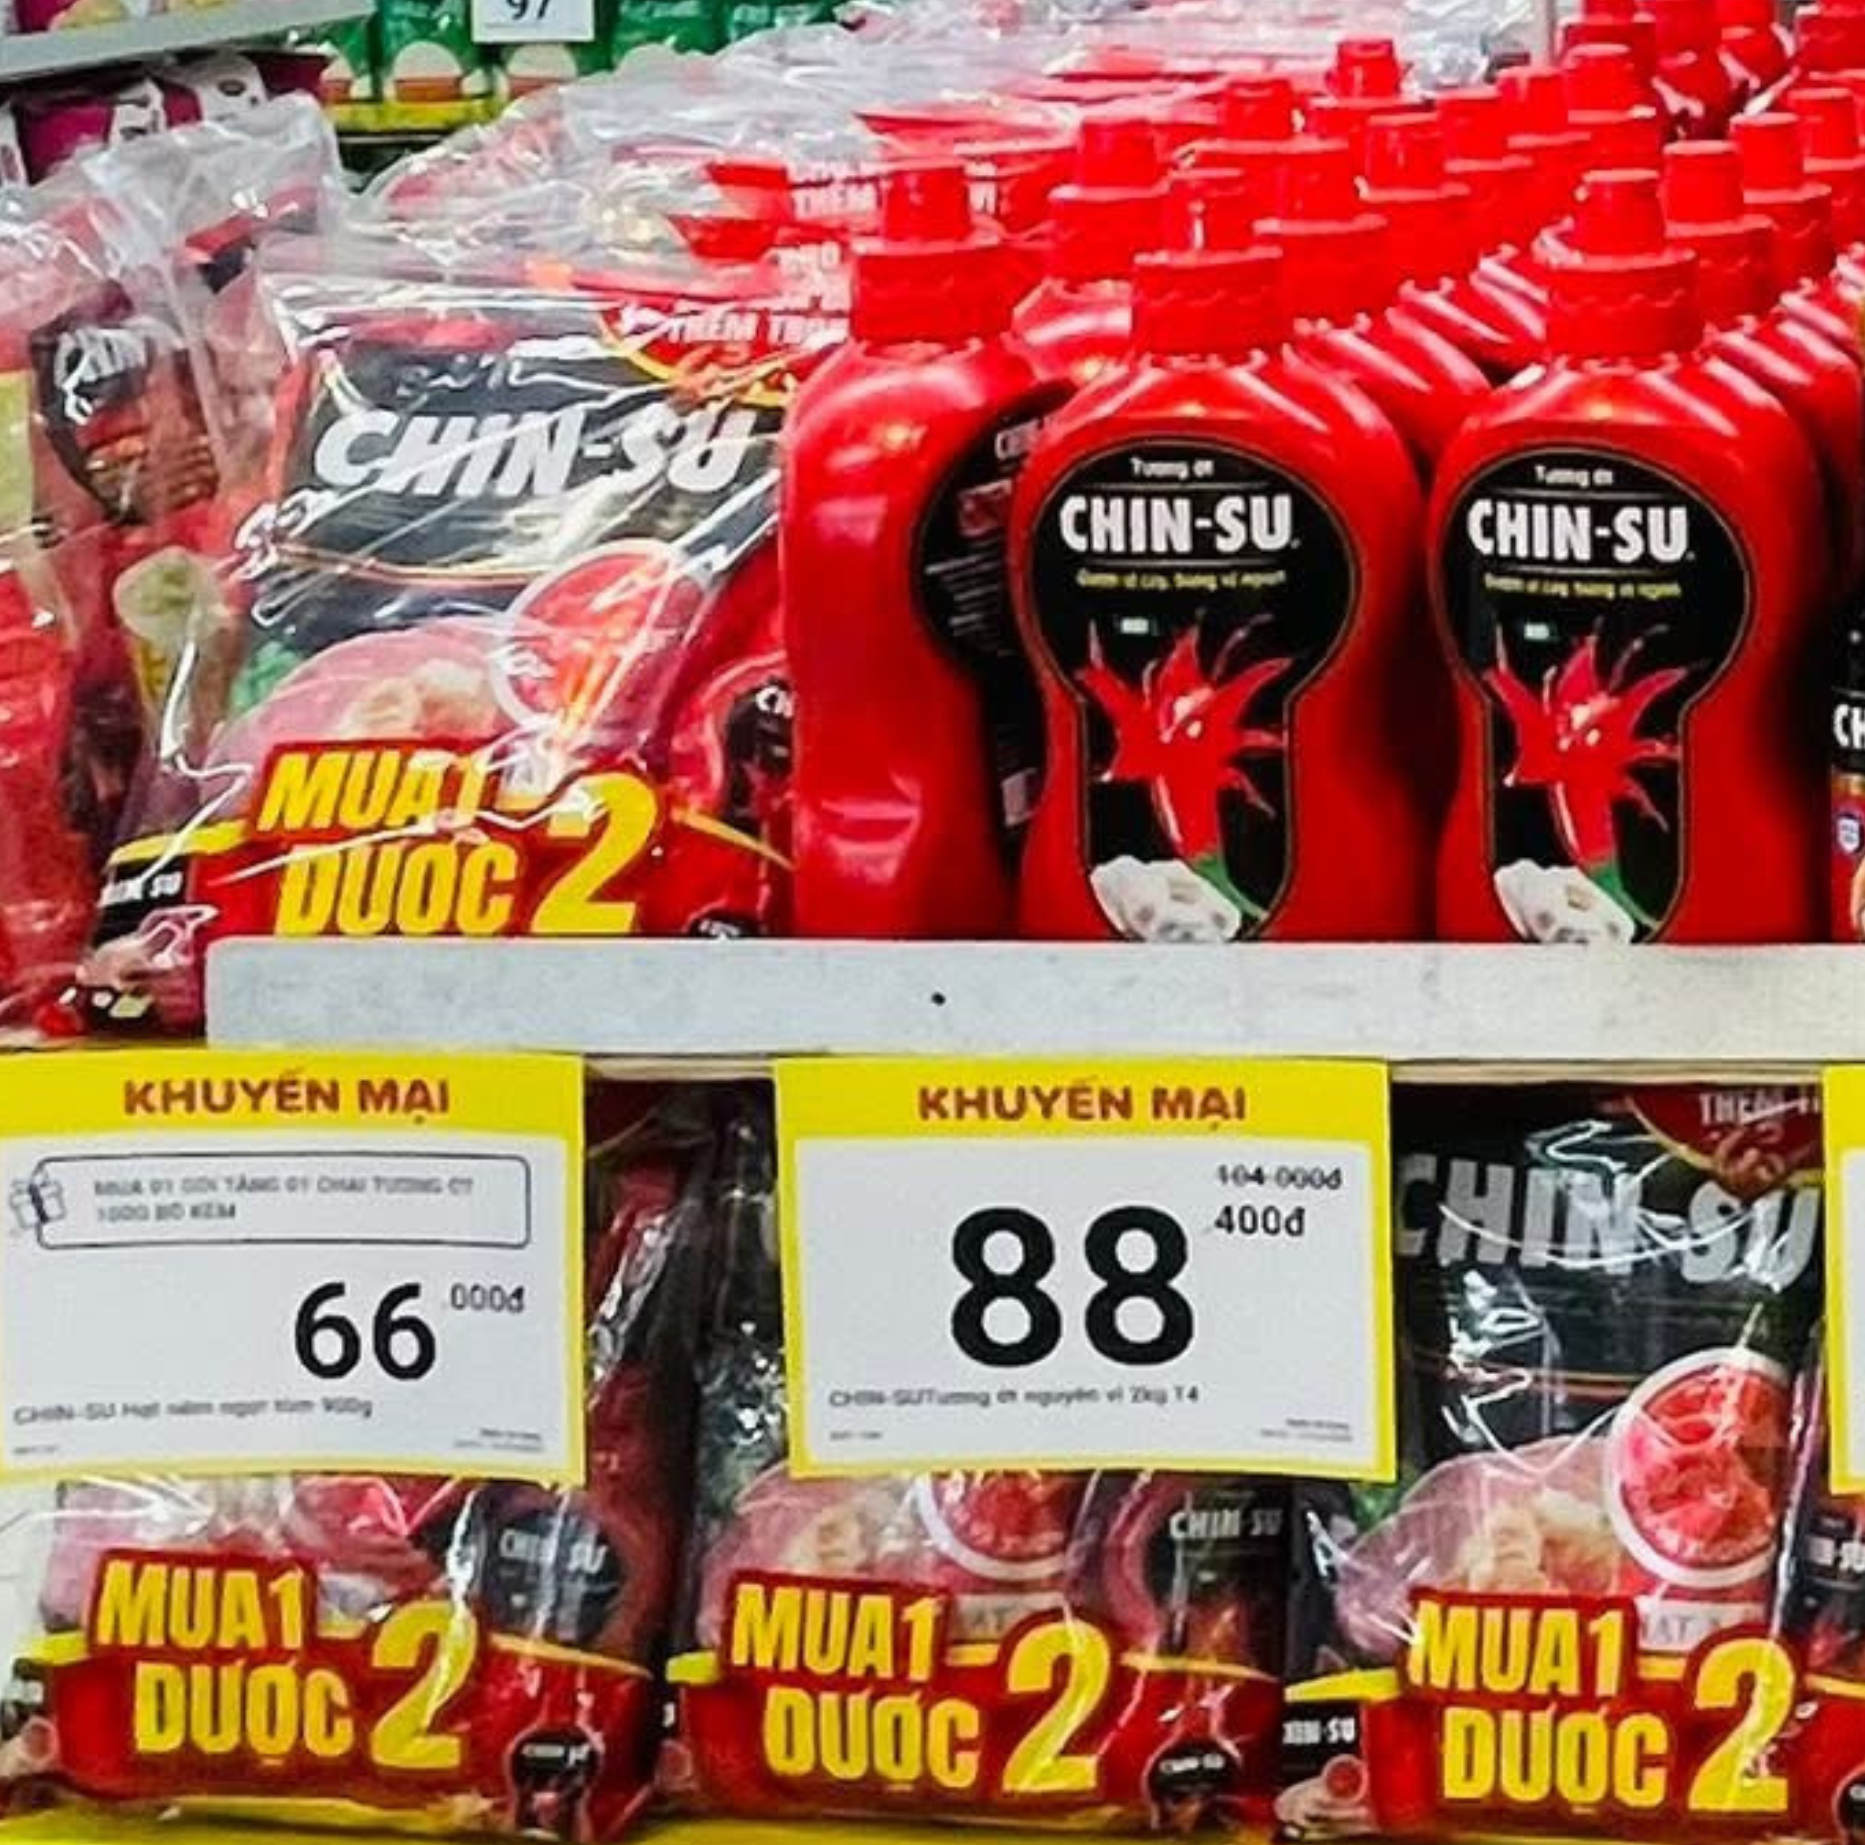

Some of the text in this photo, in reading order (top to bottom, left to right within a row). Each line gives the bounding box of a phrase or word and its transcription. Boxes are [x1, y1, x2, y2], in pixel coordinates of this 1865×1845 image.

[1060, 494, 1292, 553] CHIN-SU
[1466, 498, 1688, 563] CHIN-SU
[530, 772, 659, 934] 2
[123, 1070, 450, 1125] KHUYẾN MẠI
[918, 1076, 1247, 1132] KHUYẾN MẠI
[294, 1281, 437, 1381] 66
[951, 1206, 1196, 1368] 88
[371, 1598, 478, 1769] 2
[1002, 1619, 1111, 1793] 2
[1688, 1637, 1797, 1813] 2
